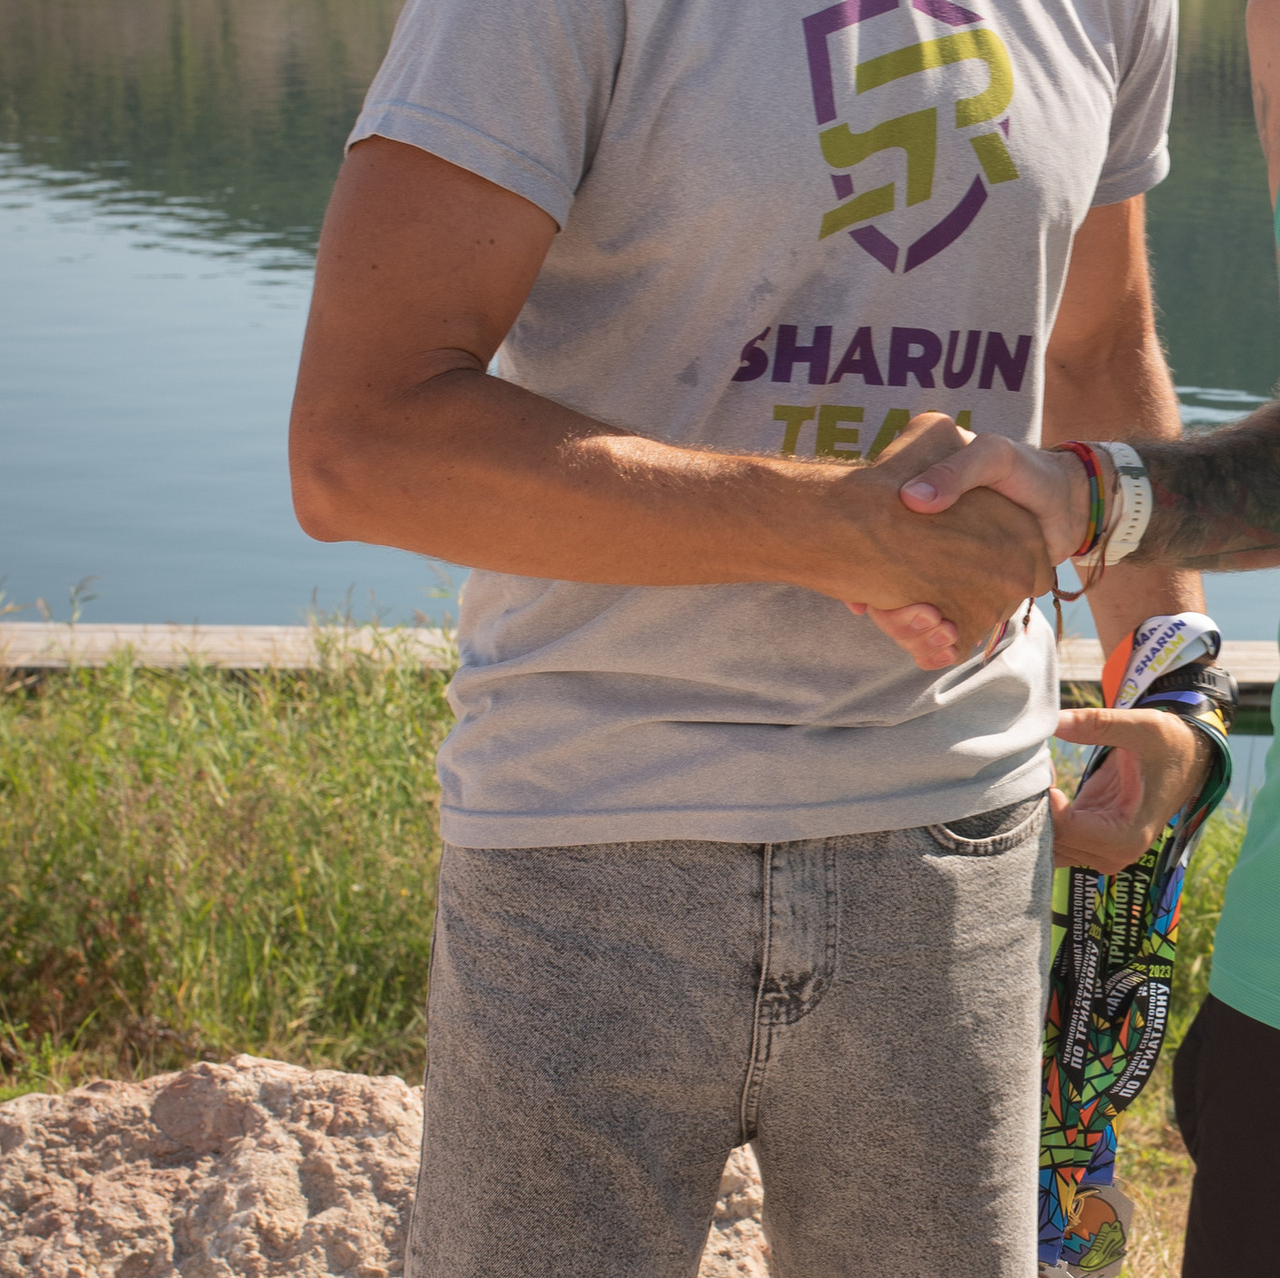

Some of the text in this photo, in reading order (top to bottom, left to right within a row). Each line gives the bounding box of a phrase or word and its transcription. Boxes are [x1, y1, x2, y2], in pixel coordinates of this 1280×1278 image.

[731, 324, 1033, 392] SHARUN
[772, 404, 973, 461] TEA
[1134, 619, 1188, 677] SHARUN
[1147, 633, 1186, 673] TEAM
[1072, 872, 1085, 941] СЕВАСТОПОЛЯ
[1062, 1009, 1079, 1064] ЧЕМПИОНАТ
[1075, 939, 1093, 1007] СЕВАСТОПОЛЯ
[1075, 942, 1099, 1041] ТРИАТЛОНУ
[1148, 964, 1171, 978] 2023
[1070, 1044, 1085, 1070] ПО
[1109, 1050, 1143, 1094] ЧЕМПИОНАТ
[1139, 982, 1157, 1049] СЕВАСТОПОЛЯ
[1118, 1079, 1141, 1098] ПО
[1133, 982, 1170, 1077] ТРИАТЛОНУ
